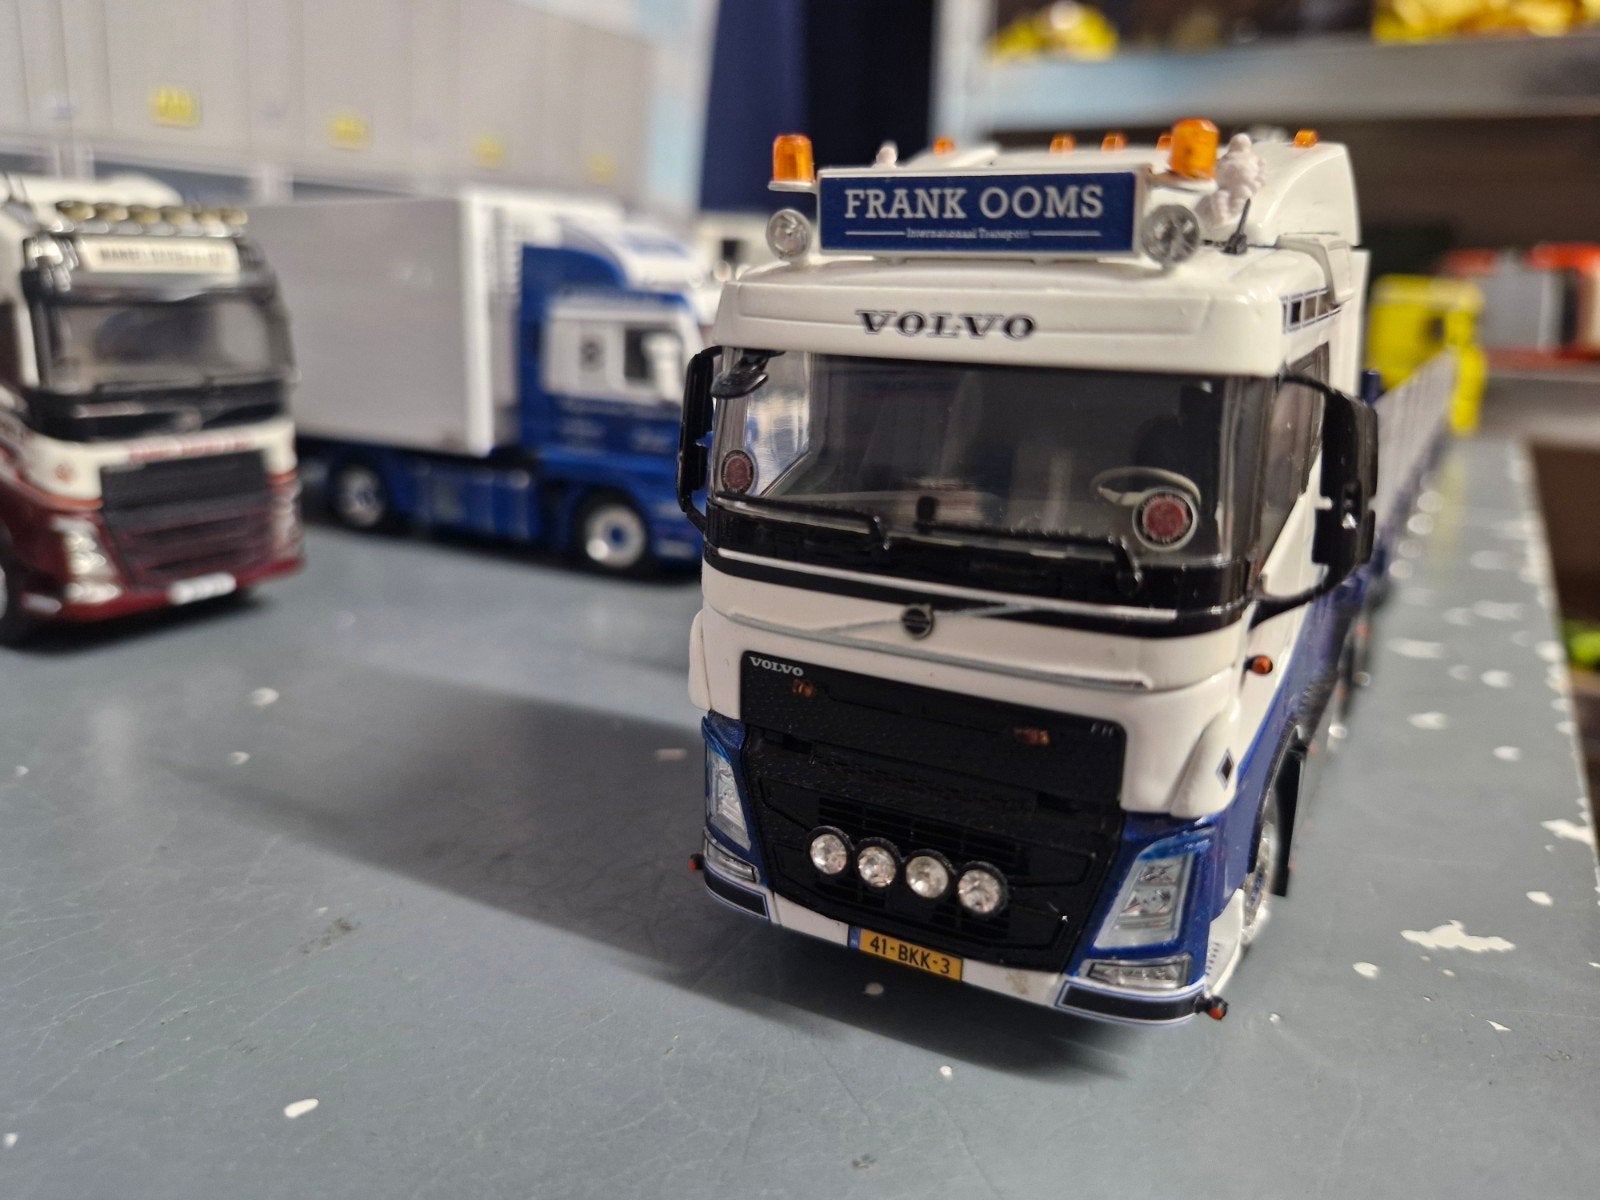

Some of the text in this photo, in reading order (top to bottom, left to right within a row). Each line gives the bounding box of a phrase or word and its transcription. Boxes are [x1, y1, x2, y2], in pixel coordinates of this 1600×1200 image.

[844, 184, 1104, 219] FRANK OOMS
[855, 309, 1036, 341] VOLVO
[749, 656, 804, 677] VOLVO
[869, 935, 951, 975] 41-BKK-3
